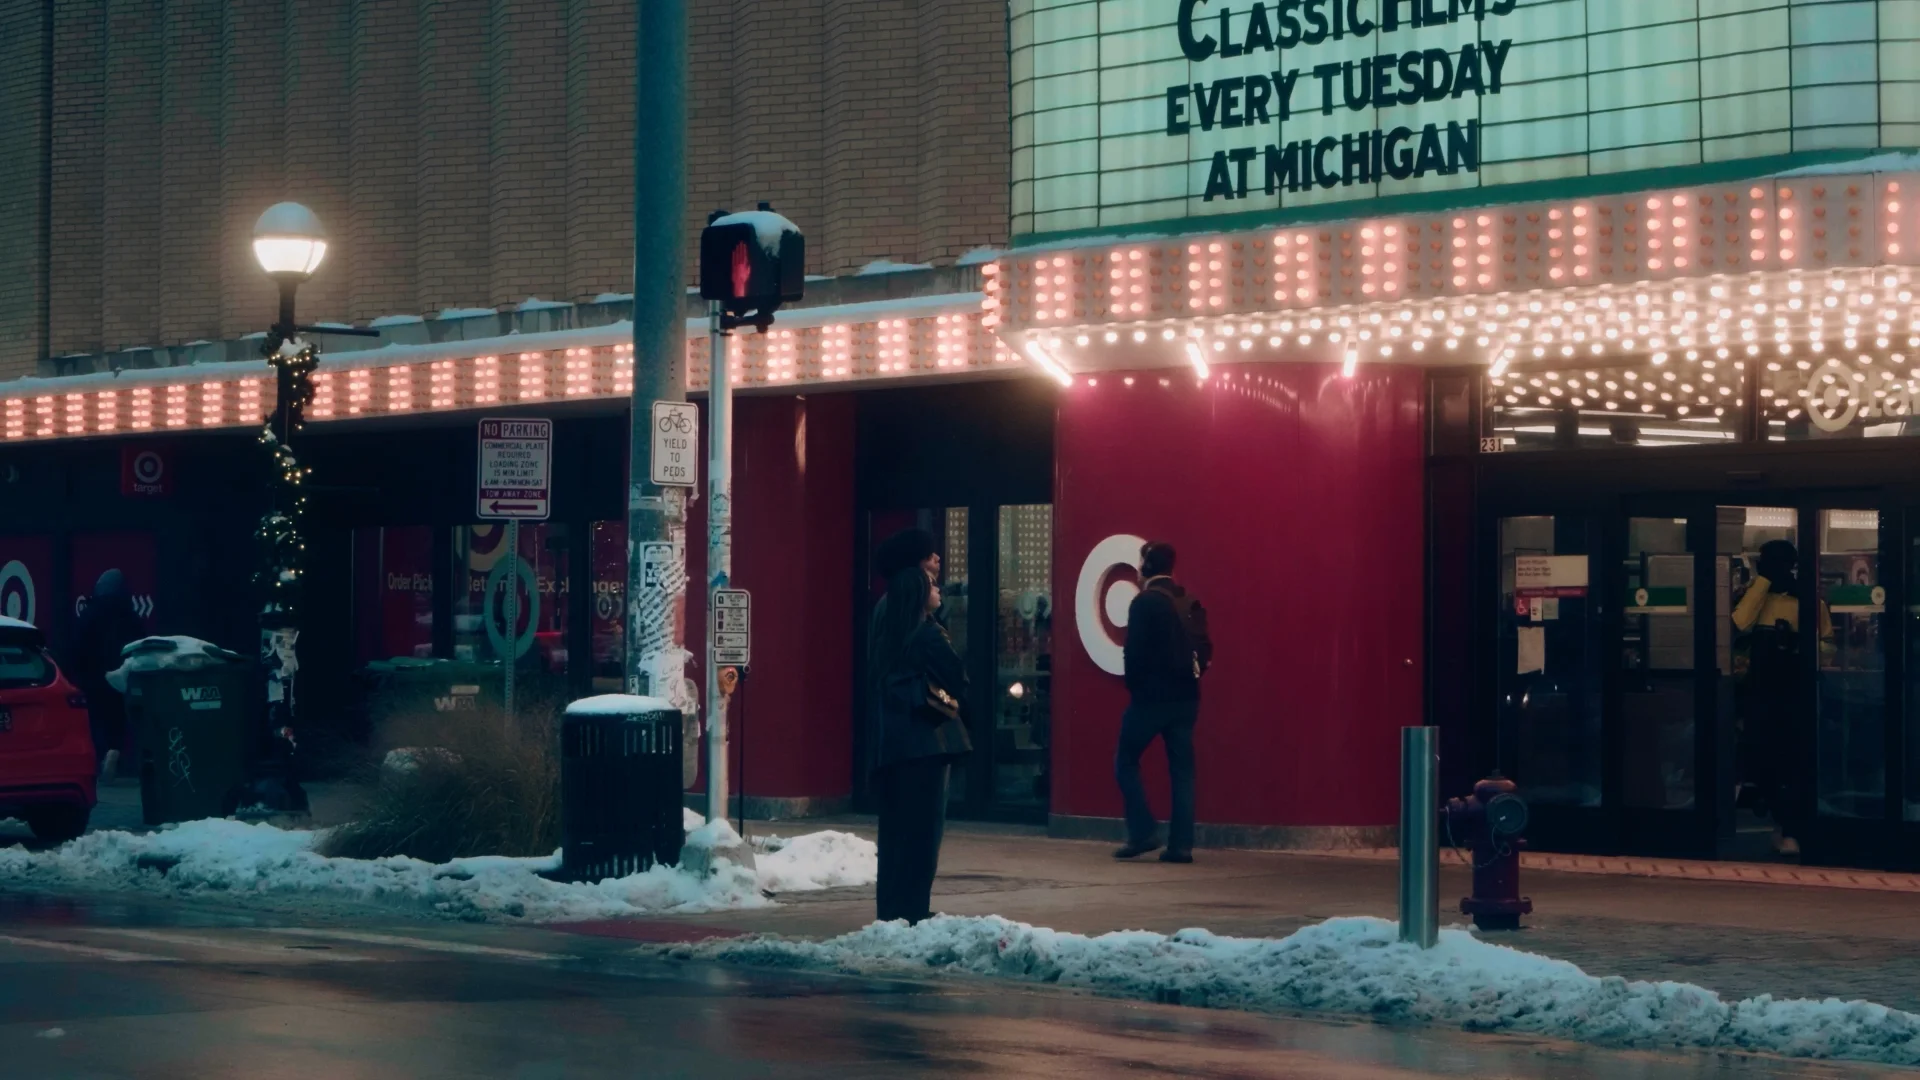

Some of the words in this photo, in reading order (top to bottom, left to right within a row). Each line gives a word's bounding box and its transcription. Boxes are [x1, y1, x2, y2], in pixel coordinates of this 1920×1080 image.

[1177, 0, 1374, 62] CLASSIC
[1167, 69, 1299, 136] EVERY
[1313, 39, 1513, 116] TUESDAY
[1203, 146, 1257, 202] AT
[1264, 118, 1480, 196] MICHIGAN
[484, 423, 498, 437] NO
[503, 424, 547, 437] PARKING
[485, 442, 523, 450] COMMERCIAL
[525, 442, 545, 450] PLATE
[663, 438, 687, 449] YIELD
[1481, 438, 1501, 452] 231
[497, 451, 531, 459] REQUIRED
[670, 452, 681, 463] TO
[490, 460, 518, 469] LOADING
[520, 460, 539, 469] ZONE
[494, 469, 501, 477] 15
[502, 469, 516, 477] MIN
[517, 469, 534, 477] LIMIT
[663, 466, 686, 477] PEDS
[133, 483, 164, 495] target
[486, 490, 500, 498] TOW
[502, 490, 520, 498] AWAY
[523, 490, 542, 499] ZONE
[388, 571, 411, 591] Order
